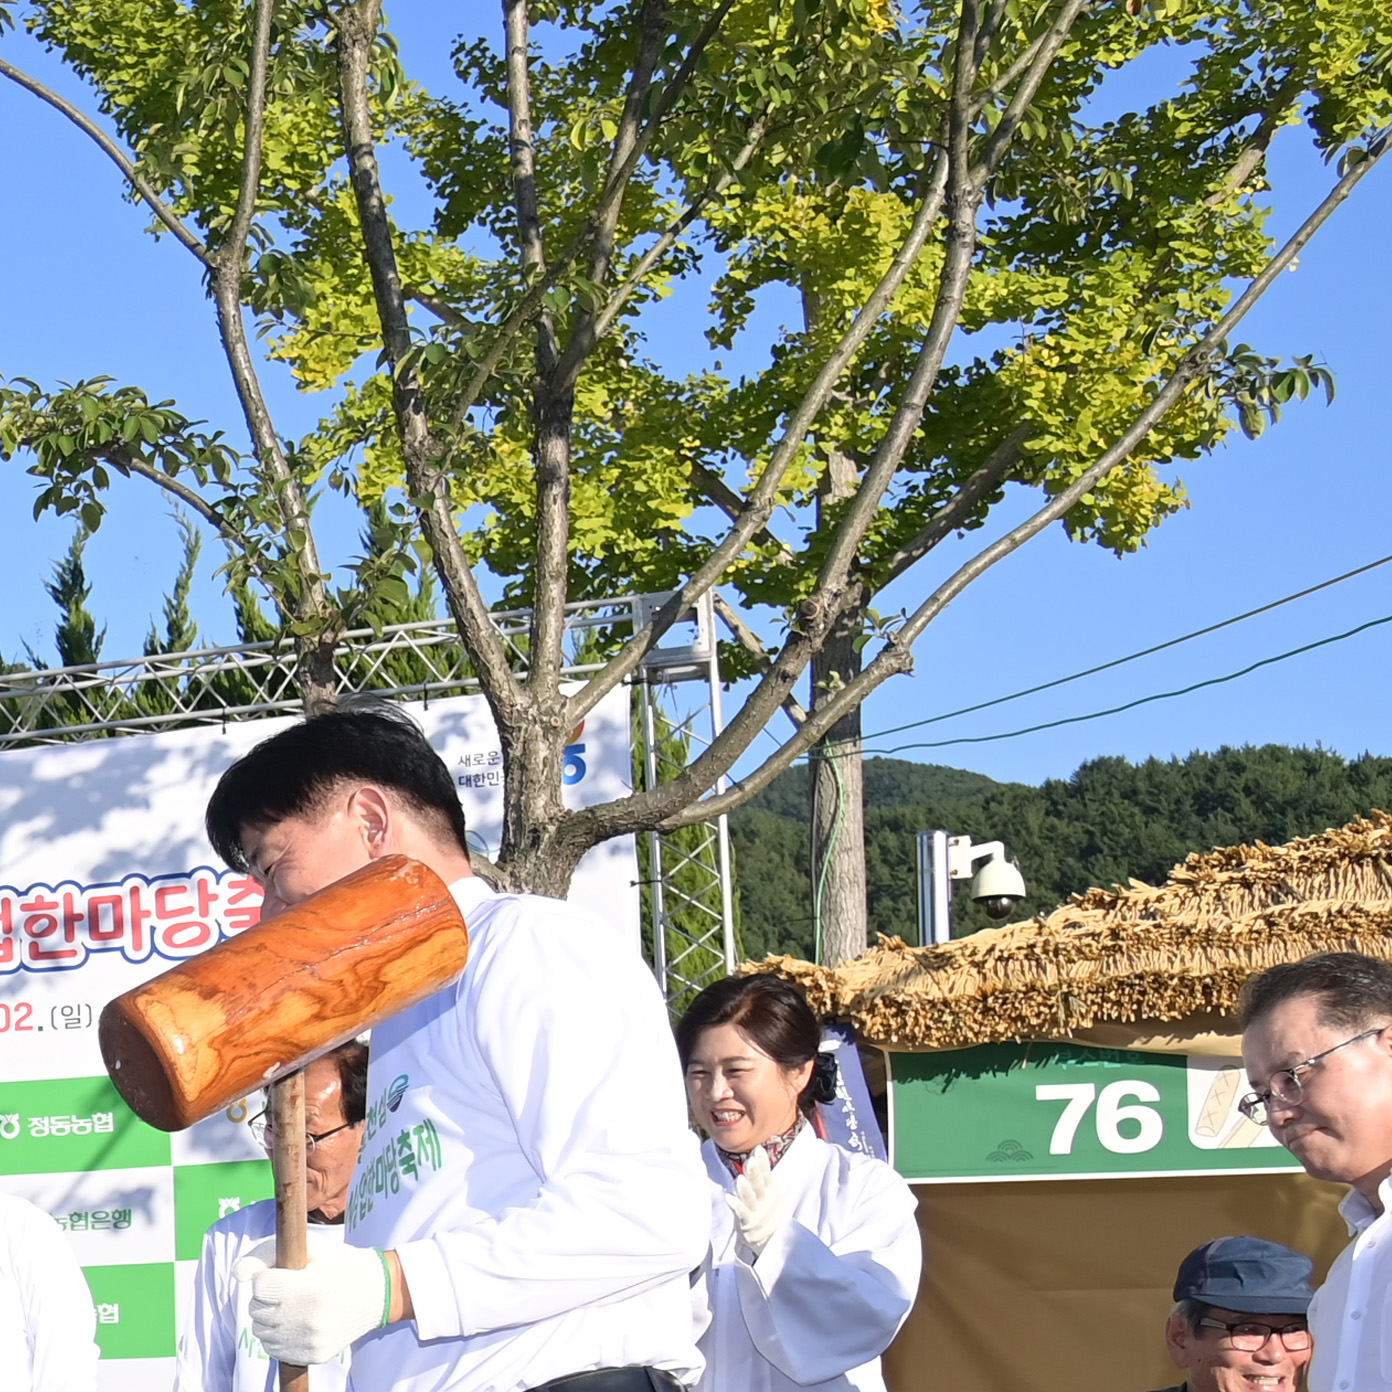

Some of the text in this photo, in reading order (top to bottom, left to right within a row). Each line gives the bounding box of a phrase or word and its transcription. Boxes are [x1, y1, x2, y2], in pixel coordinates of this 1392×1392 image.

[458, 751, 501, 767] 새로운
[458, 771, 505, 788] 대한민
[27, 1112, 115, 1138] 정동농협
[1035, 1079, 1164, 1155] 76
